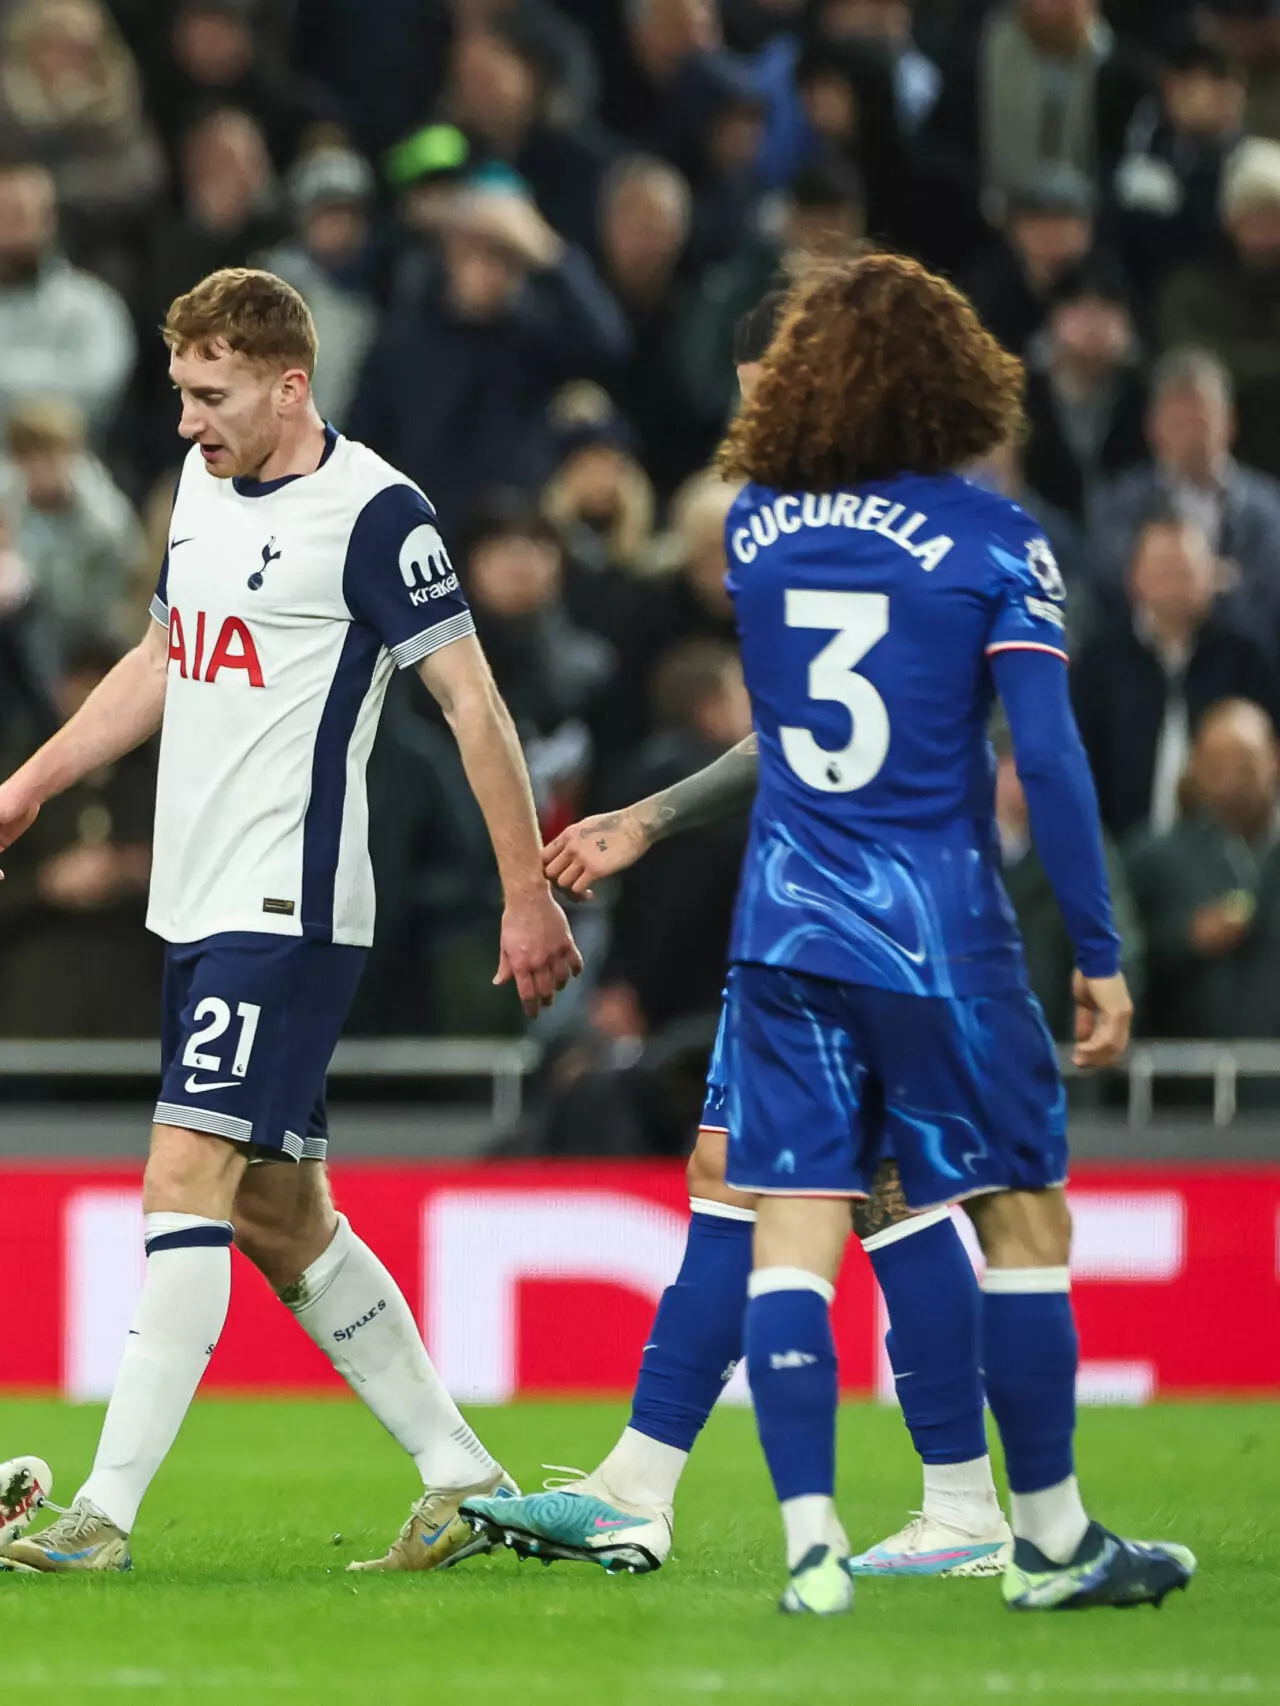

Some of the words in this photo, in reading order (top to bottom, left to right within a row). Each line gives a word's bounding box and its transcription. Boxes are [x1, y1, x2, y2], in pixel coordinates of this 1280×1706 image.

[732, 492, 954, 572] CUCURELLA
[780, 589, 890, 792] 3
[182, 997, 261, 1077] 21
[333, 1299, 386, 1342] Spurs
